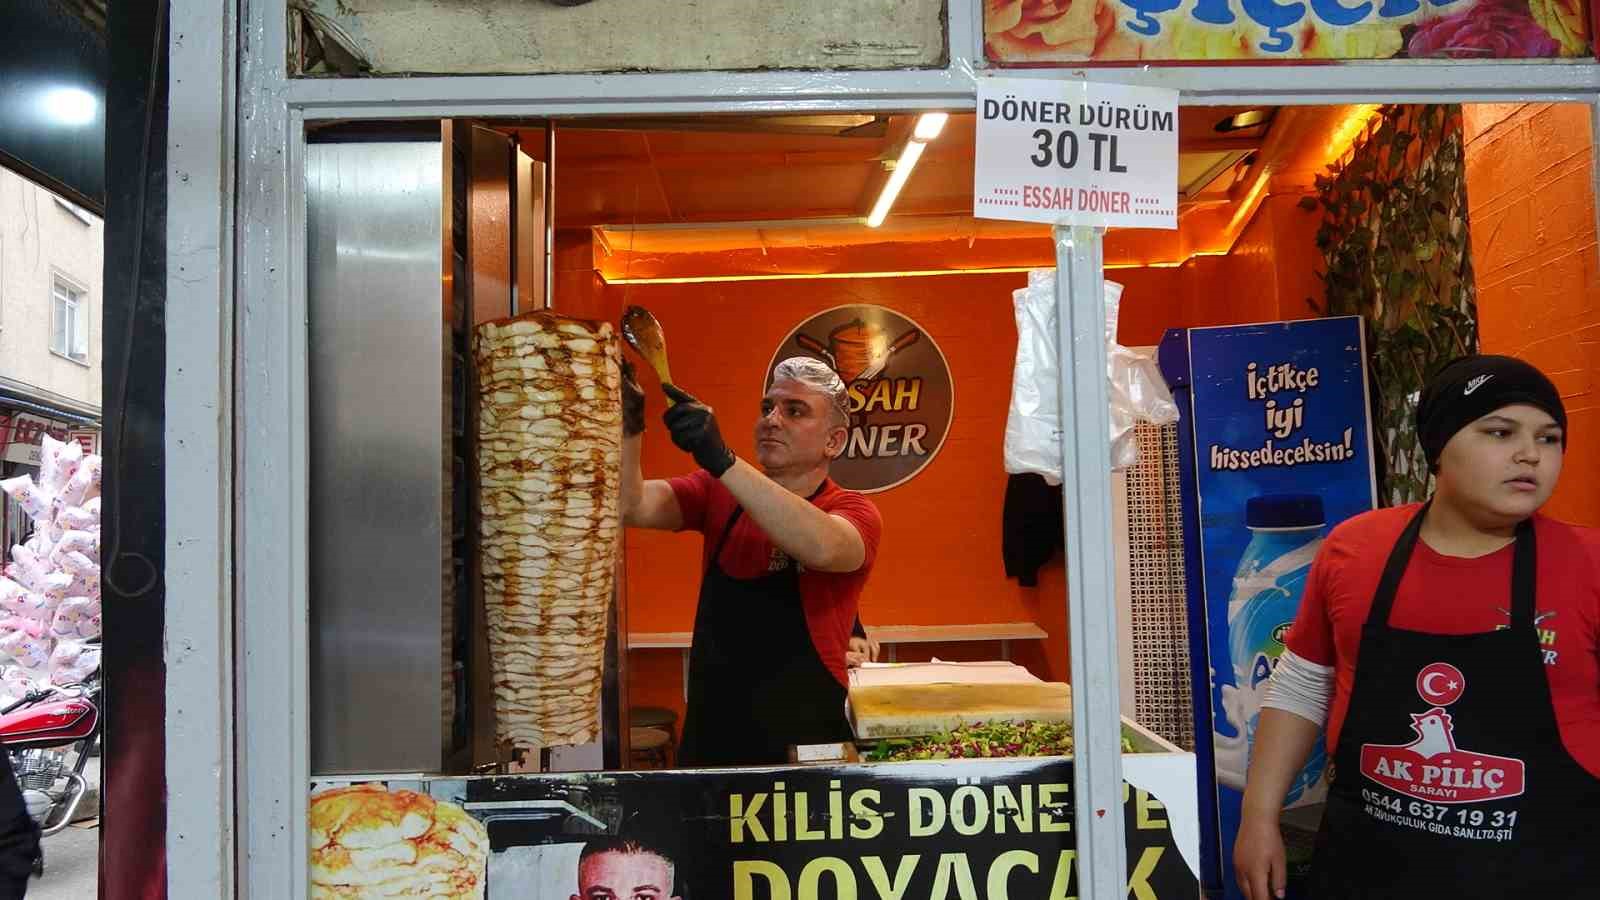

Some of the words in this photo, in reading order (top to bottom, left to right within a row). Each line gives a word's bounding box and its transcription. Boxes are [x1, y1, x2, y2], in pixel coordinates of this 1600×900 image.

[983, 95, 1071, 124] DÖNER
[1079, 101, 1174, 132] DÜRÜM
[1031, 128, 1079, 169] 30
[1088, 133, 1127, 173] TL
[1023, 185, 1074, 210] ESSAH
[1078, 184, 1131, 214] DÖNER
[1247, 362, 1319, 399] İçtikçe
[1210, 427, 1354, 470] hissedeceksin!
[1374, 757, 1413, 782] AK
[1422, 759, 1505, 794] PİLİÇ
[1409, 785, 1457, 798] SARAYI
[729, 780, 881, 843] KİLİS
[1361, 788, 1402, 813] 0544
[1410, 801, 1449, 821] 637
[1457, 809, 1484, 827] 19
[1491, 811, 1518, 828] 31
[1428, 822, 1452, 836] GIDA
